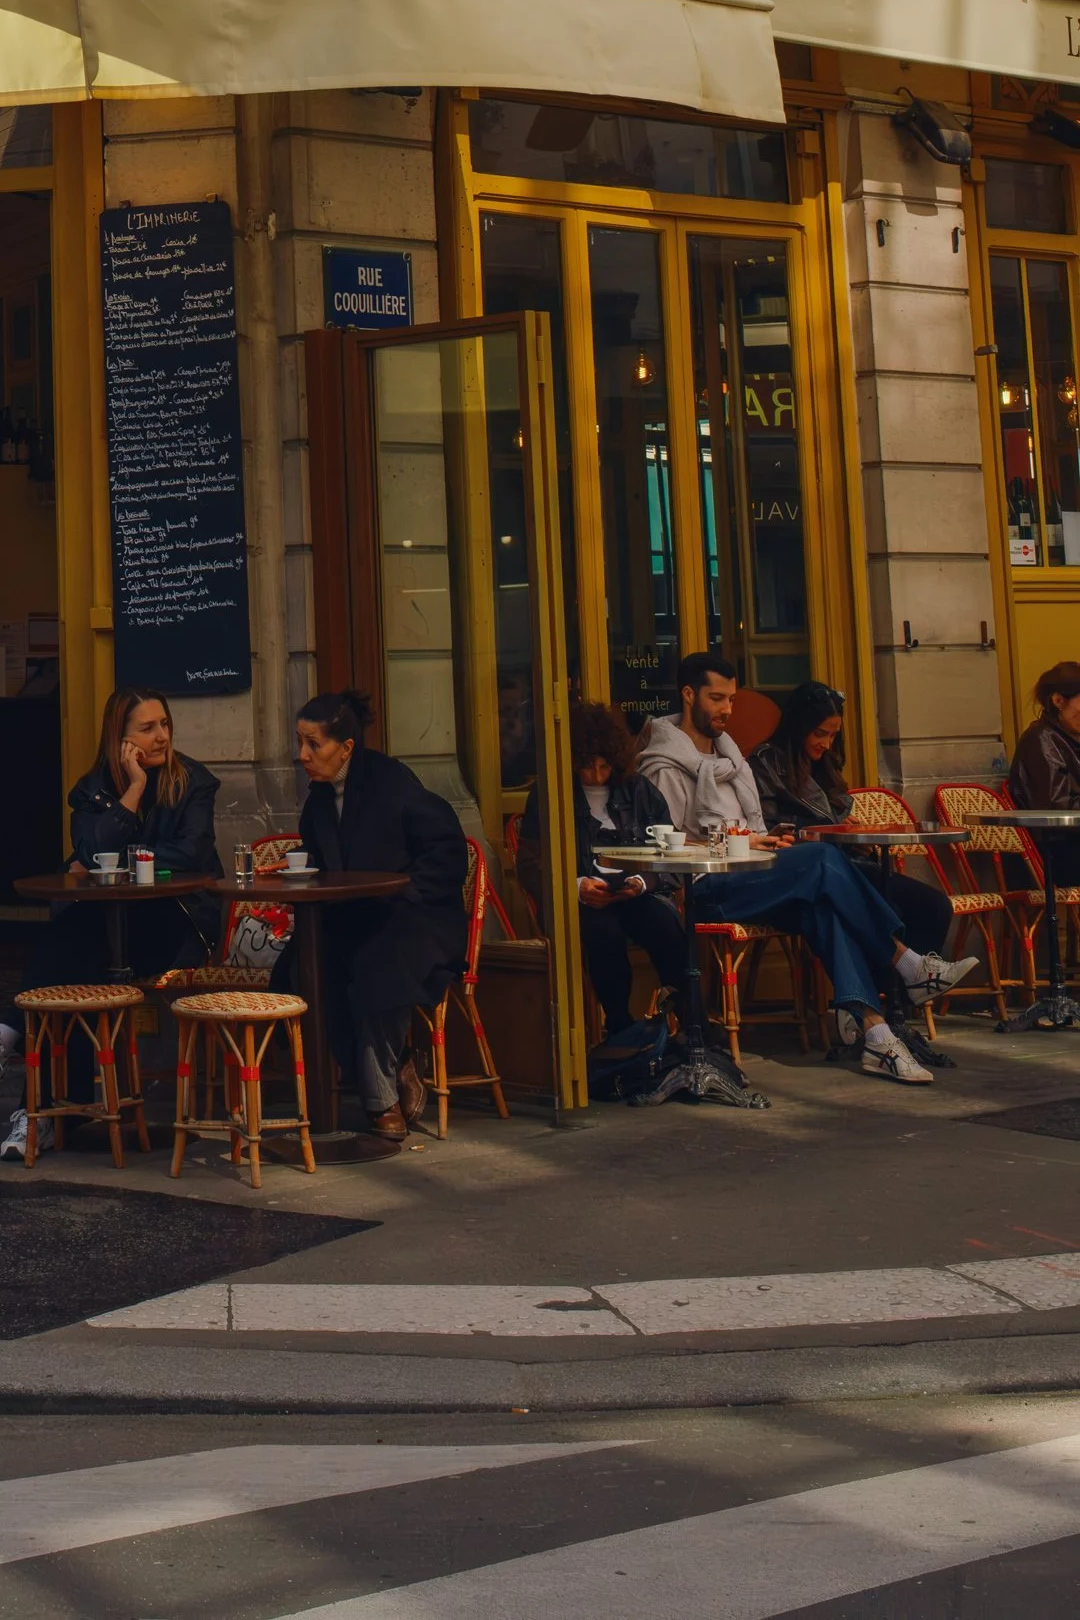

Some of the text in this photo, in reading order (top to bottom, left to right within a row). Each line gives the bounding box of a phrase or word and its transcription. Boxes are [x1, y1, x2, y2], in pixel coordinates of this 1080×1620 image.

[127, 211, 200, 230] L'IMPRIMERIE
[357, 266, 384, 287] RUE
[625, 652, 659, 669] vente
[640, 675, 647, 690] à
[620, 695, 671, 716] emporter
